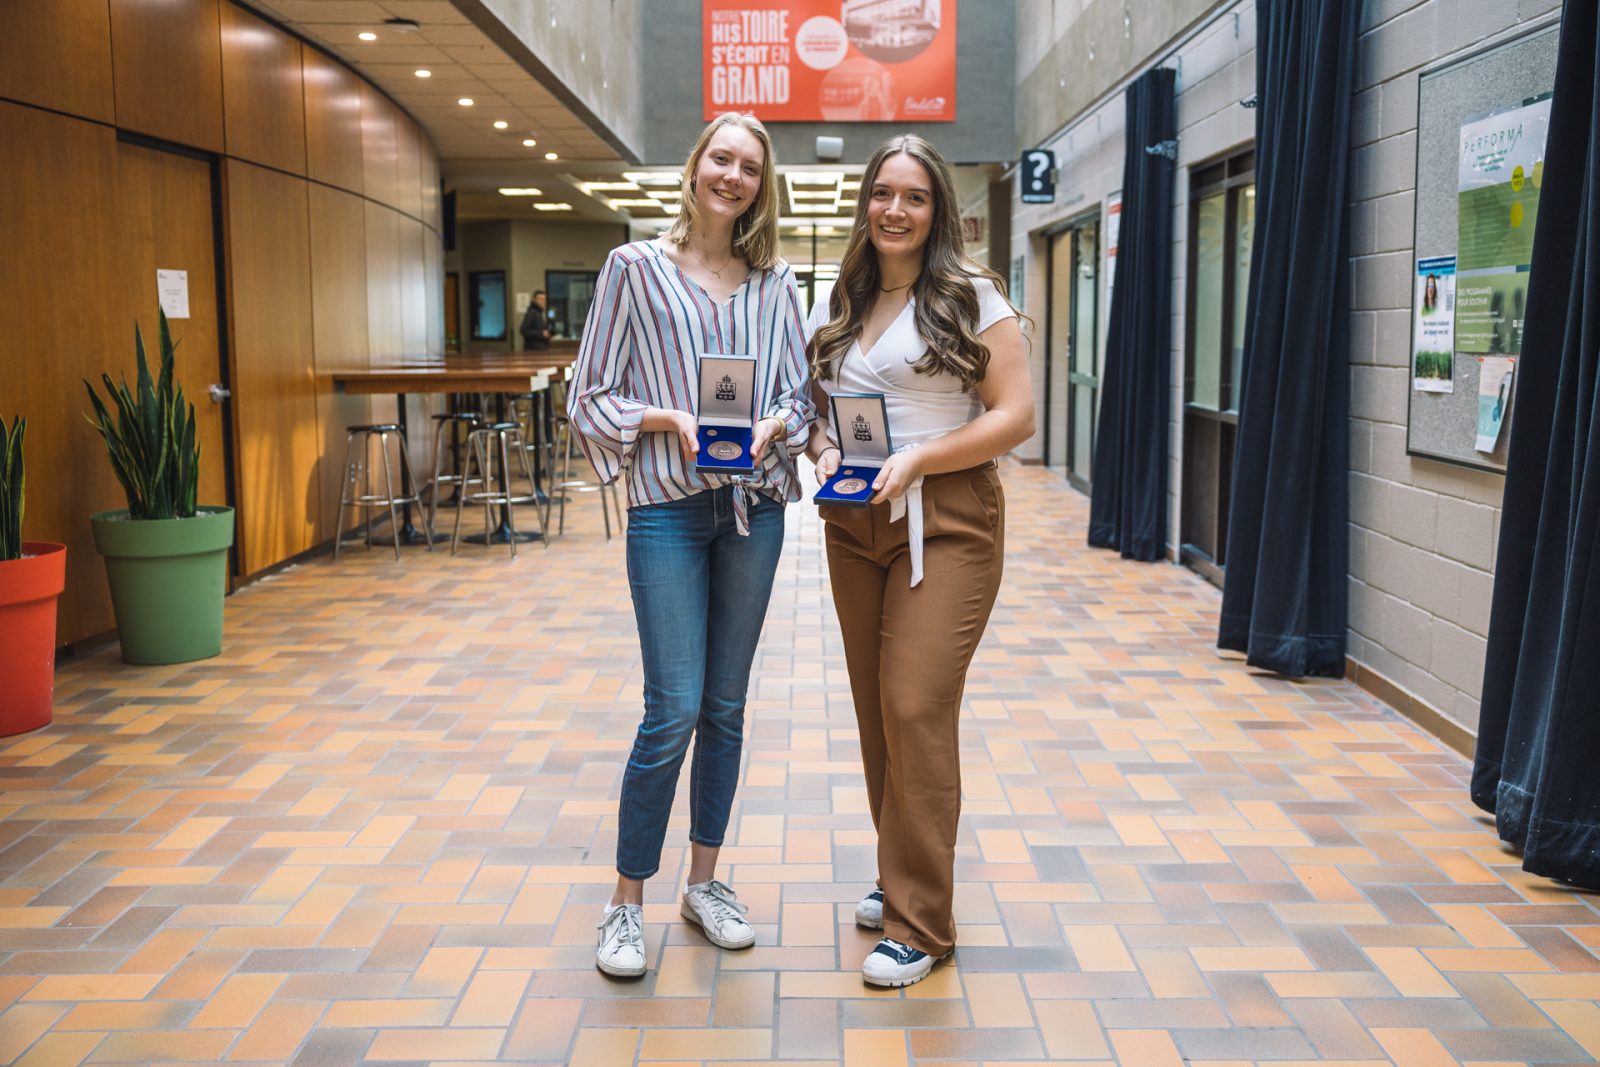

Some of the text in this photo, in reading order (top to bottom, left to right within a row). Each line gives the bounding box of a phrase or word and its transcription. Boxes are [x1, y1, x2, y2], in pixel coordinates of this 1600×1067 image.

[711, 43, 789, 64] S'ÉCRIT EN
[711, 65, 789, 105] GRAND
[1464, 122, 1524, 152] PERFORMA
